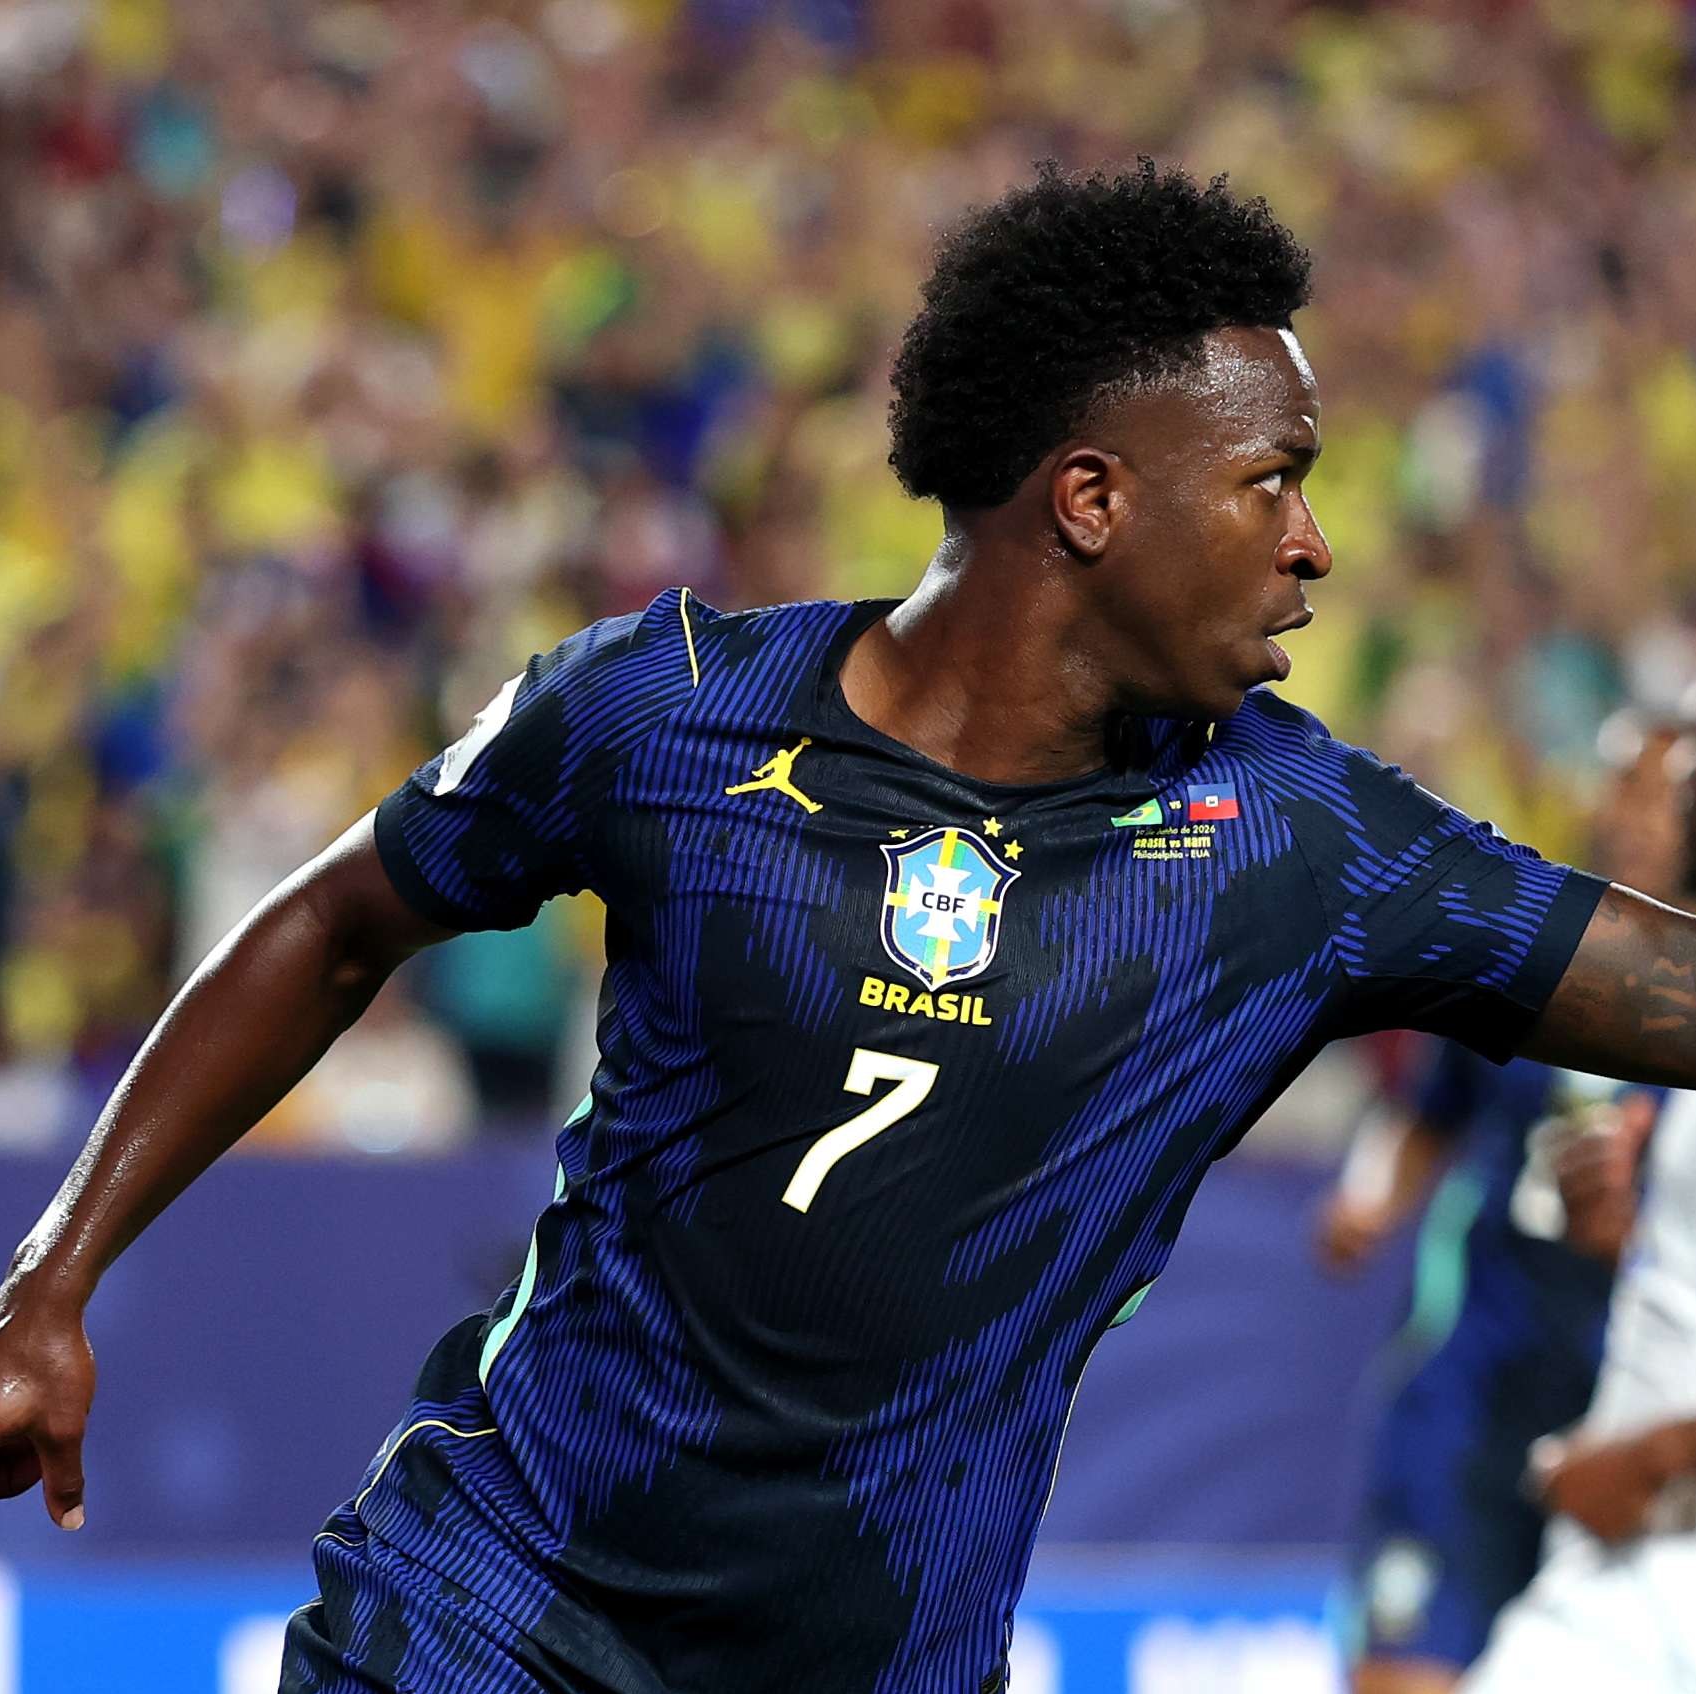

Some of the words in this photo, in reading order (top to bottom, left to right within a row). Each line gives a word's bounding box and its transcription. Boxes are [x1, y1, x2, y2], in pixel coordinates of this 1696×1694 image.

[1180, 825, 1191, 834] de
[1192, 824, 1216, 834] 2026
[1132, 849, 1183, 861] Philadelphia
[1190, 849, 1210, 858] EUA
[922, 892, 966, 913] CBF
[859, 976, 992, 1027] BRASIL
[782, 1048, 940, 1213] 7
